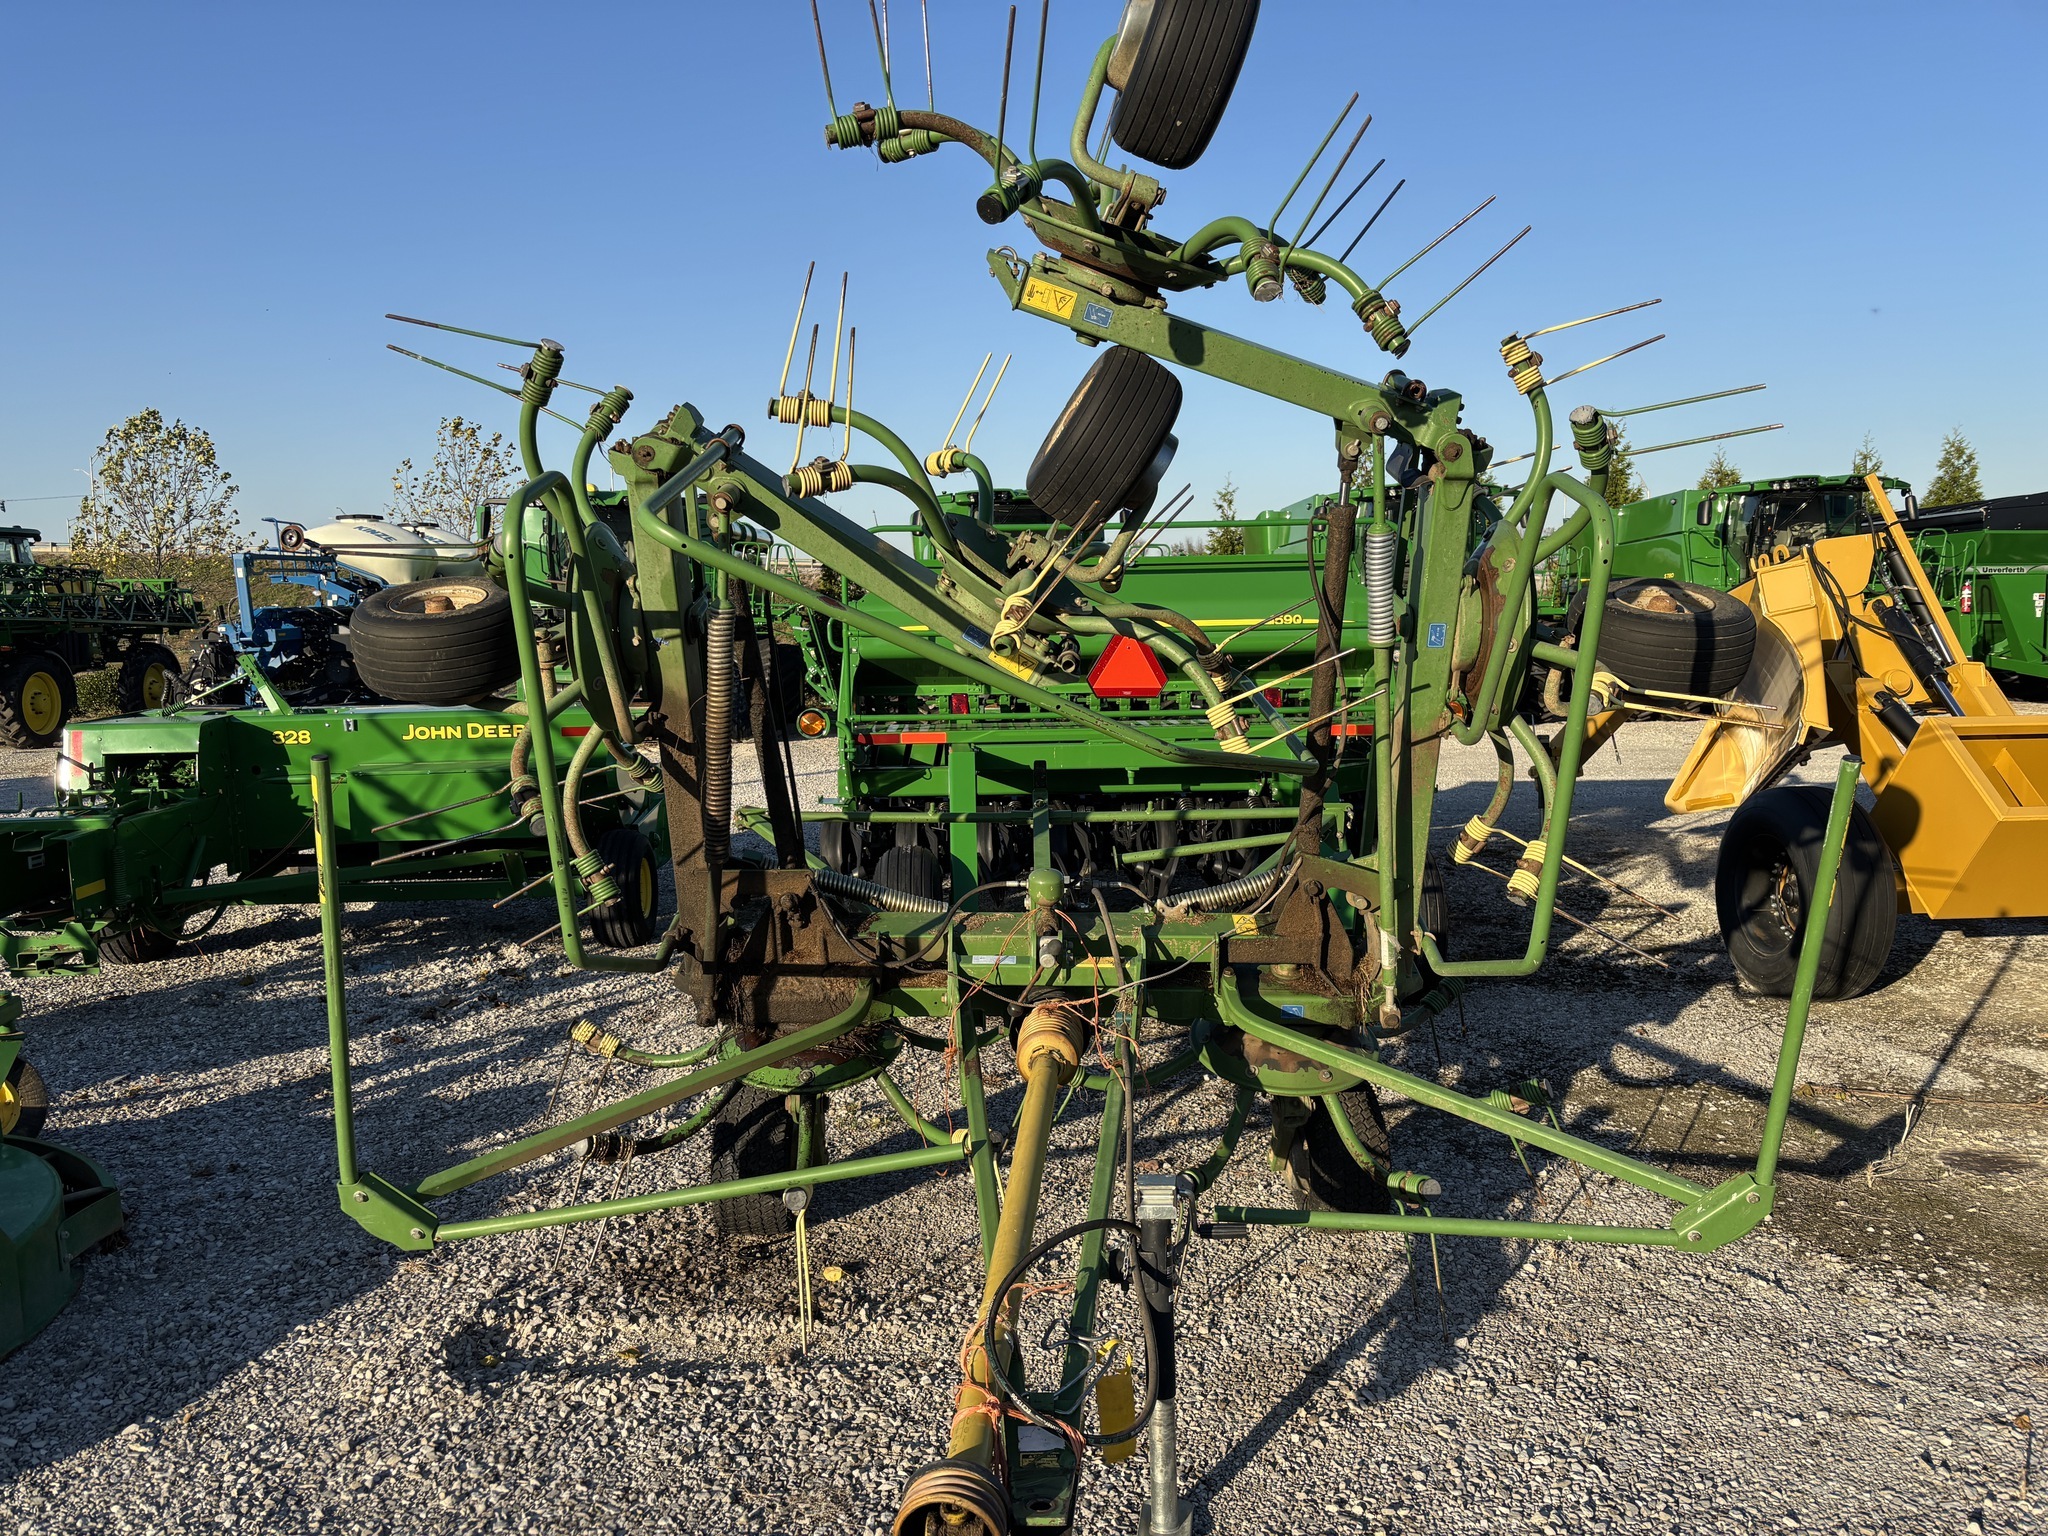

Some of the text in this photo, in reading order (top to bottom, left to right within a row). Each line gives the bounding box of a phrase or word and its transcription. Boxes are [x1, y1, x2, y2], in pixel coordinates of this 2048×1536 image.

[353, 525, 398, 543] KINZE
[272, 730, 312, 746] 328
[402, 722, 527, 741] JOHN DEER
